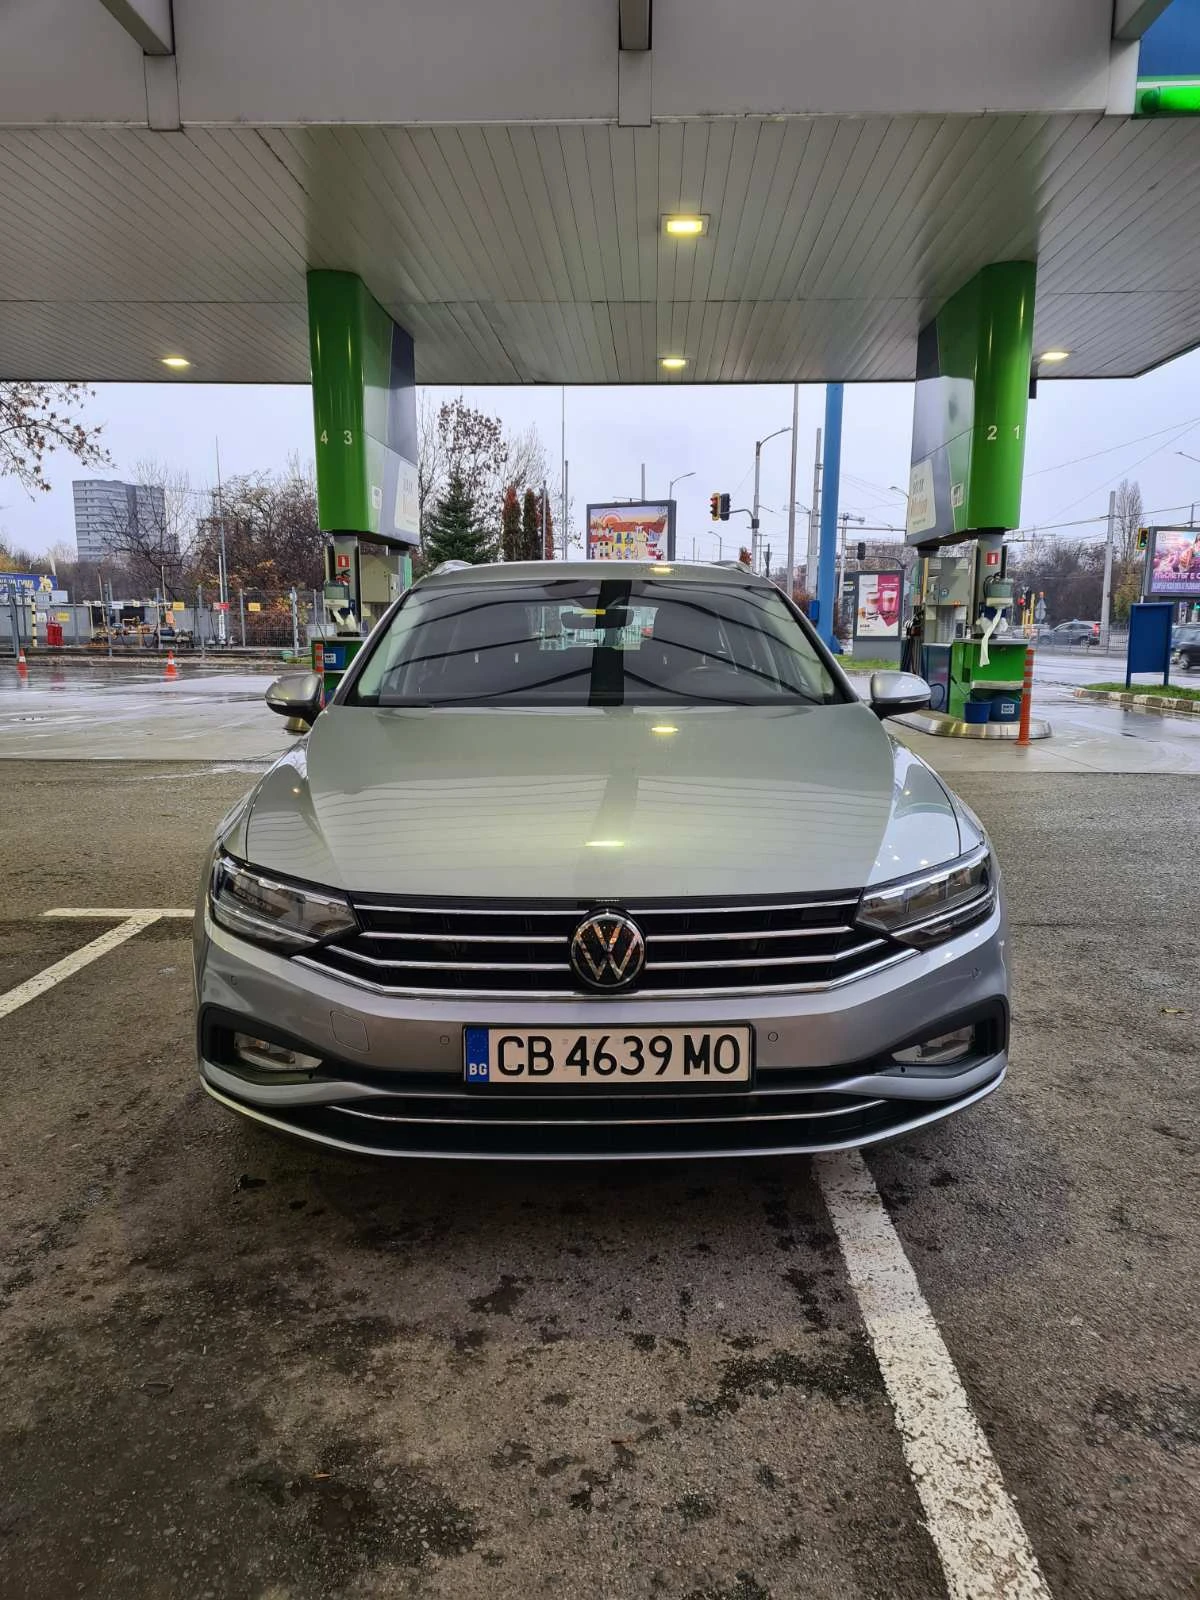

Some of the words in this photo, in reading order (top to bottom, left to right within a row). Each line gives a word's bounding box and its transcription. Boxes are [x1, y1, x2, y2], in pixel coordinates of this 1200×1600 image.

[320, 429, 329, 445] 4
[343, 430, 353, 445] 3
[987, 425, 998, 440] 2
[1013, 425, 1020, 440] 1
[468, 1063, 488, 1076] BG
[497, 1035, 554, 1076] CB
[565, 1035, 673, 1076] 4639
[683, 1034, 741, 1075] MO
